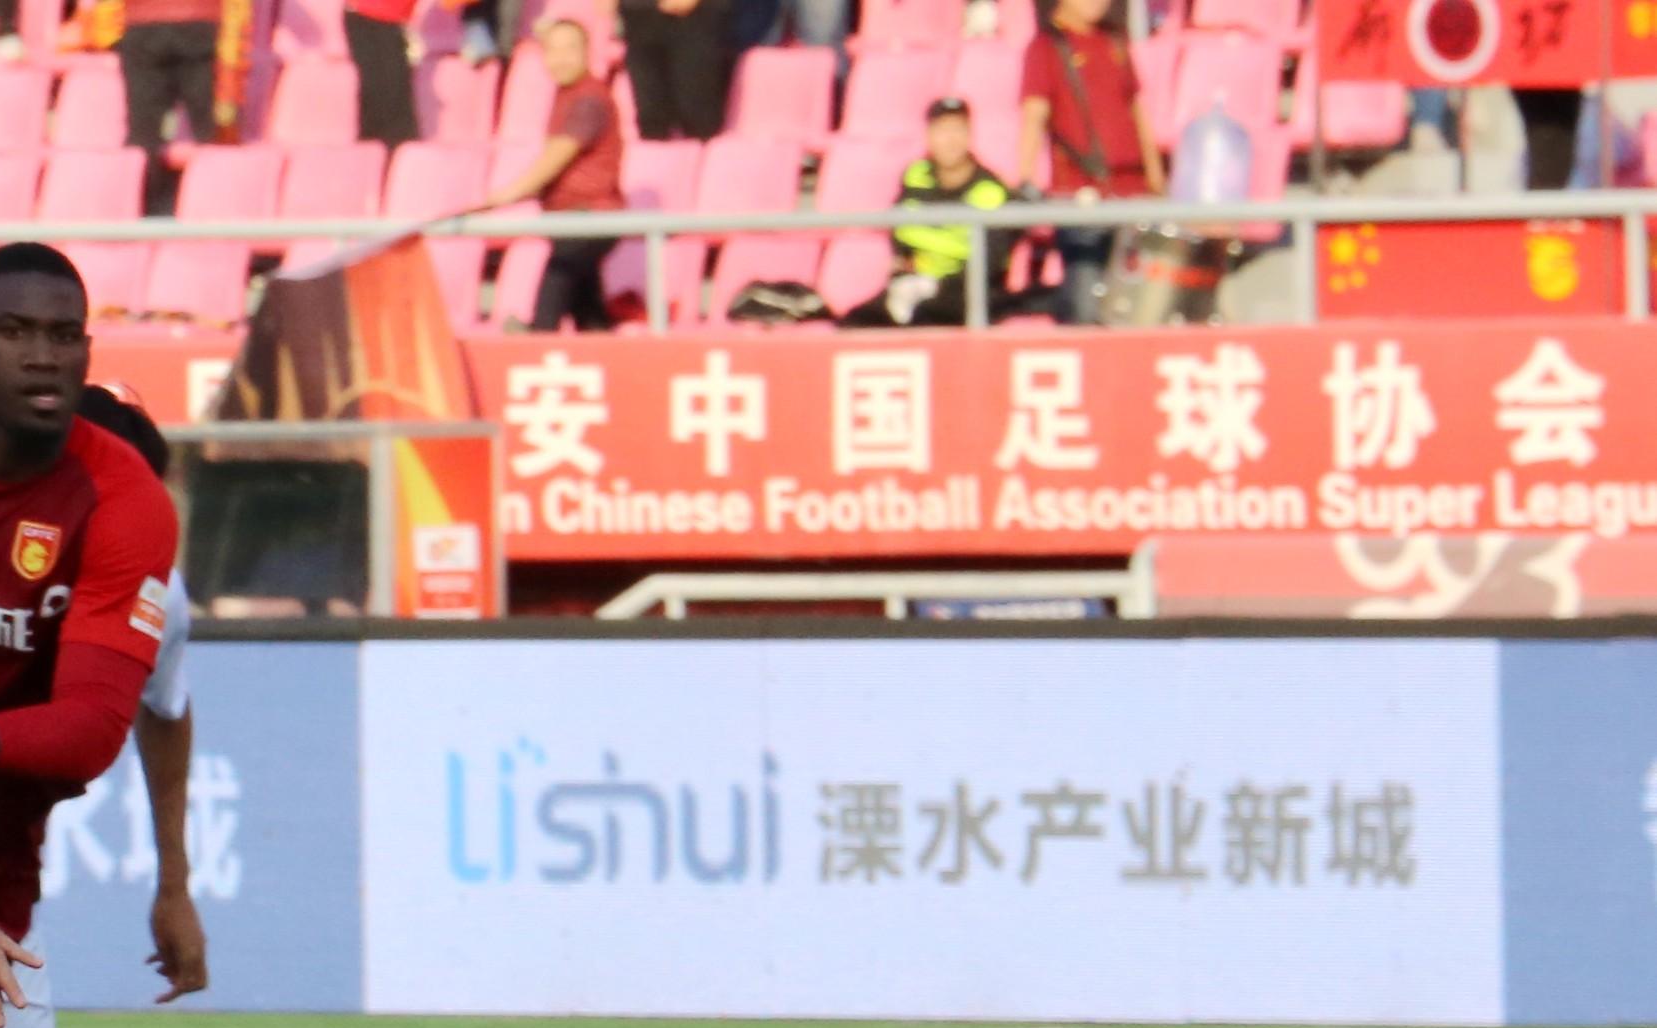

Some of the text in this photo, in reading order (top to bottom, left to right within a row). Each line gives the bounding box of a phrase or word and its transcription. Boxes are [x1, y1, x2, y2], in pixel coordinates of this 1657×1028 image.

[504, 338, 1605, 477] 安中国足球协会
[544, 478, 754, 534] Chinese
[764, 475, 980, 533] Football
[994, 473, 1306, 532] Association
[1317, 472, 1484, 538] Super
[817, 778, 1419, 886] 溧水产业新城
